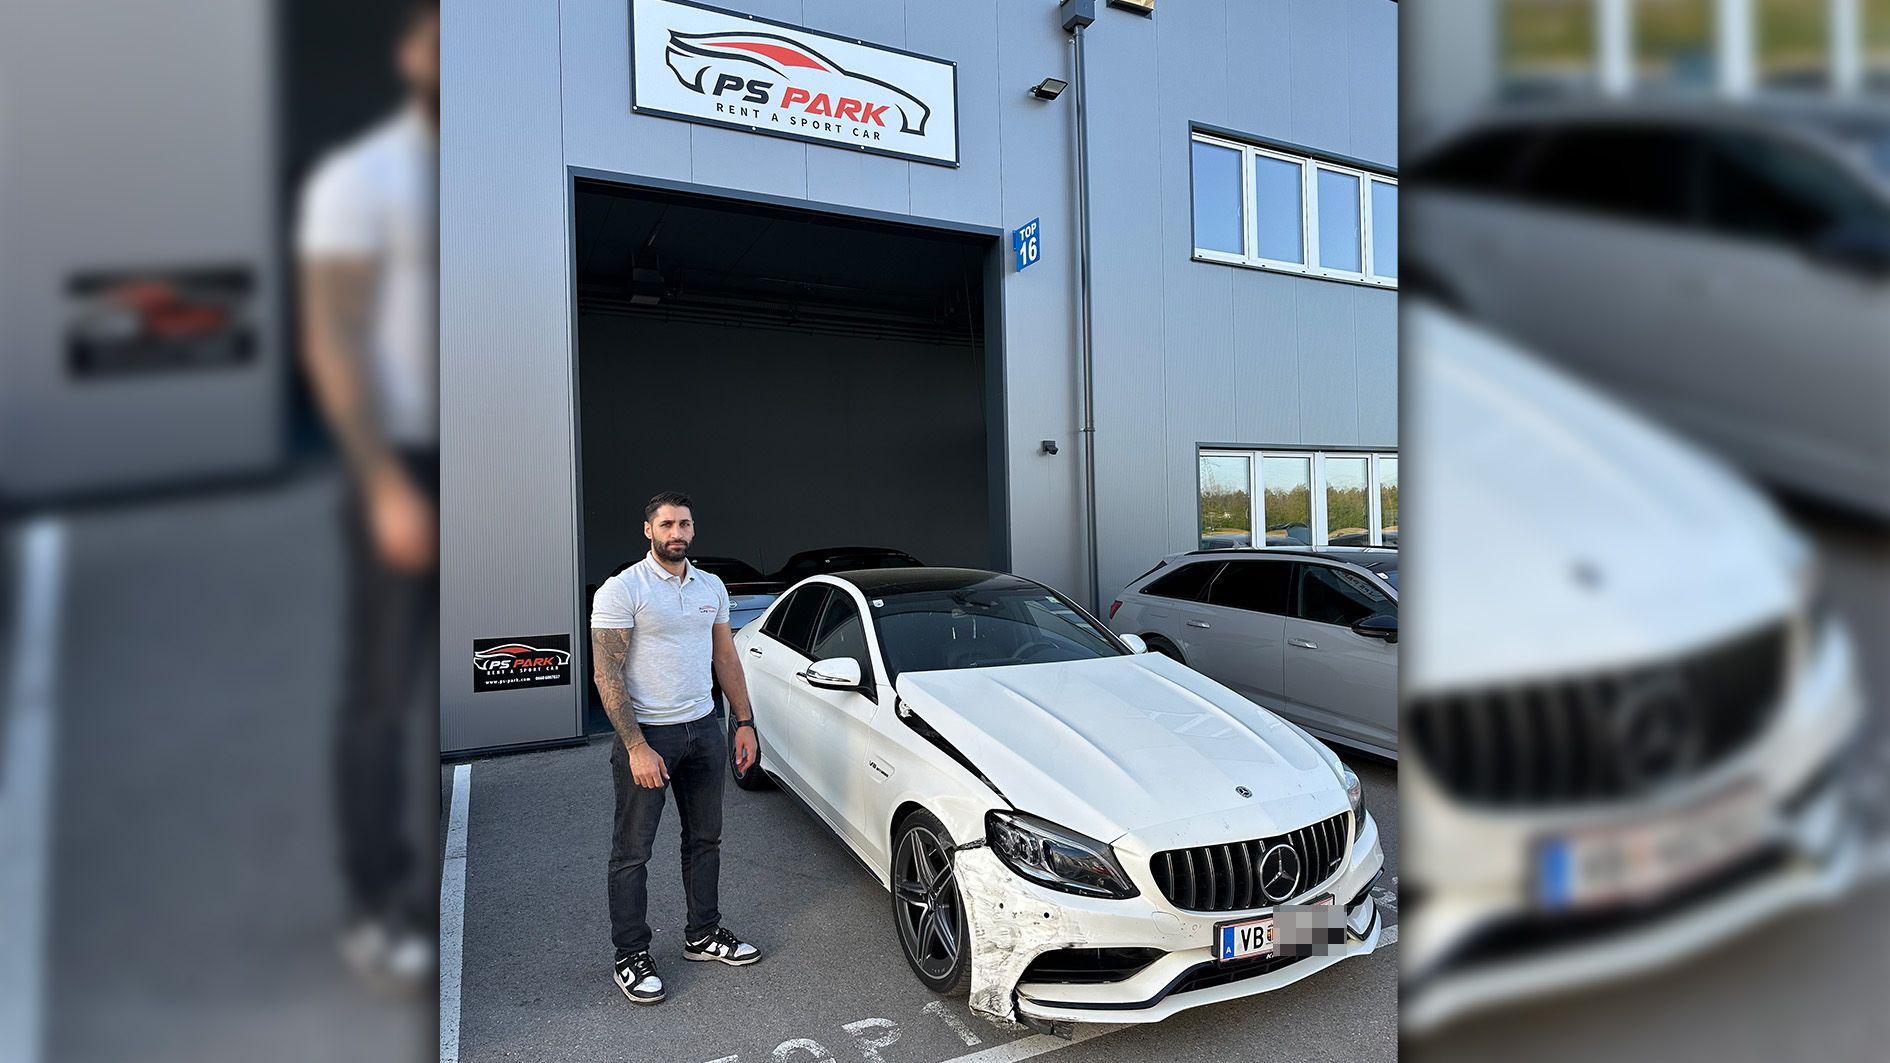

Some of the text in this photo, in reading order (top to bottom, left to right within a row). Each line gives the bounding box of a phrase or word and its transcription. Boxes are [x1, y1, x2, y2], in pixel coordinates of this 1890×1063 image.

[712, 73, 890, 128] PS PARK
[716, 102, 881, 141] RENT A SPORT CAR
[1020, 222, 1037, 241] TOP
[1020, 236, 1038, 266] 16
[488, 656, 554, 670] PS PARK
[1225, 946, 1232, 954] A
[1241, 926, 1264, 952] VB
